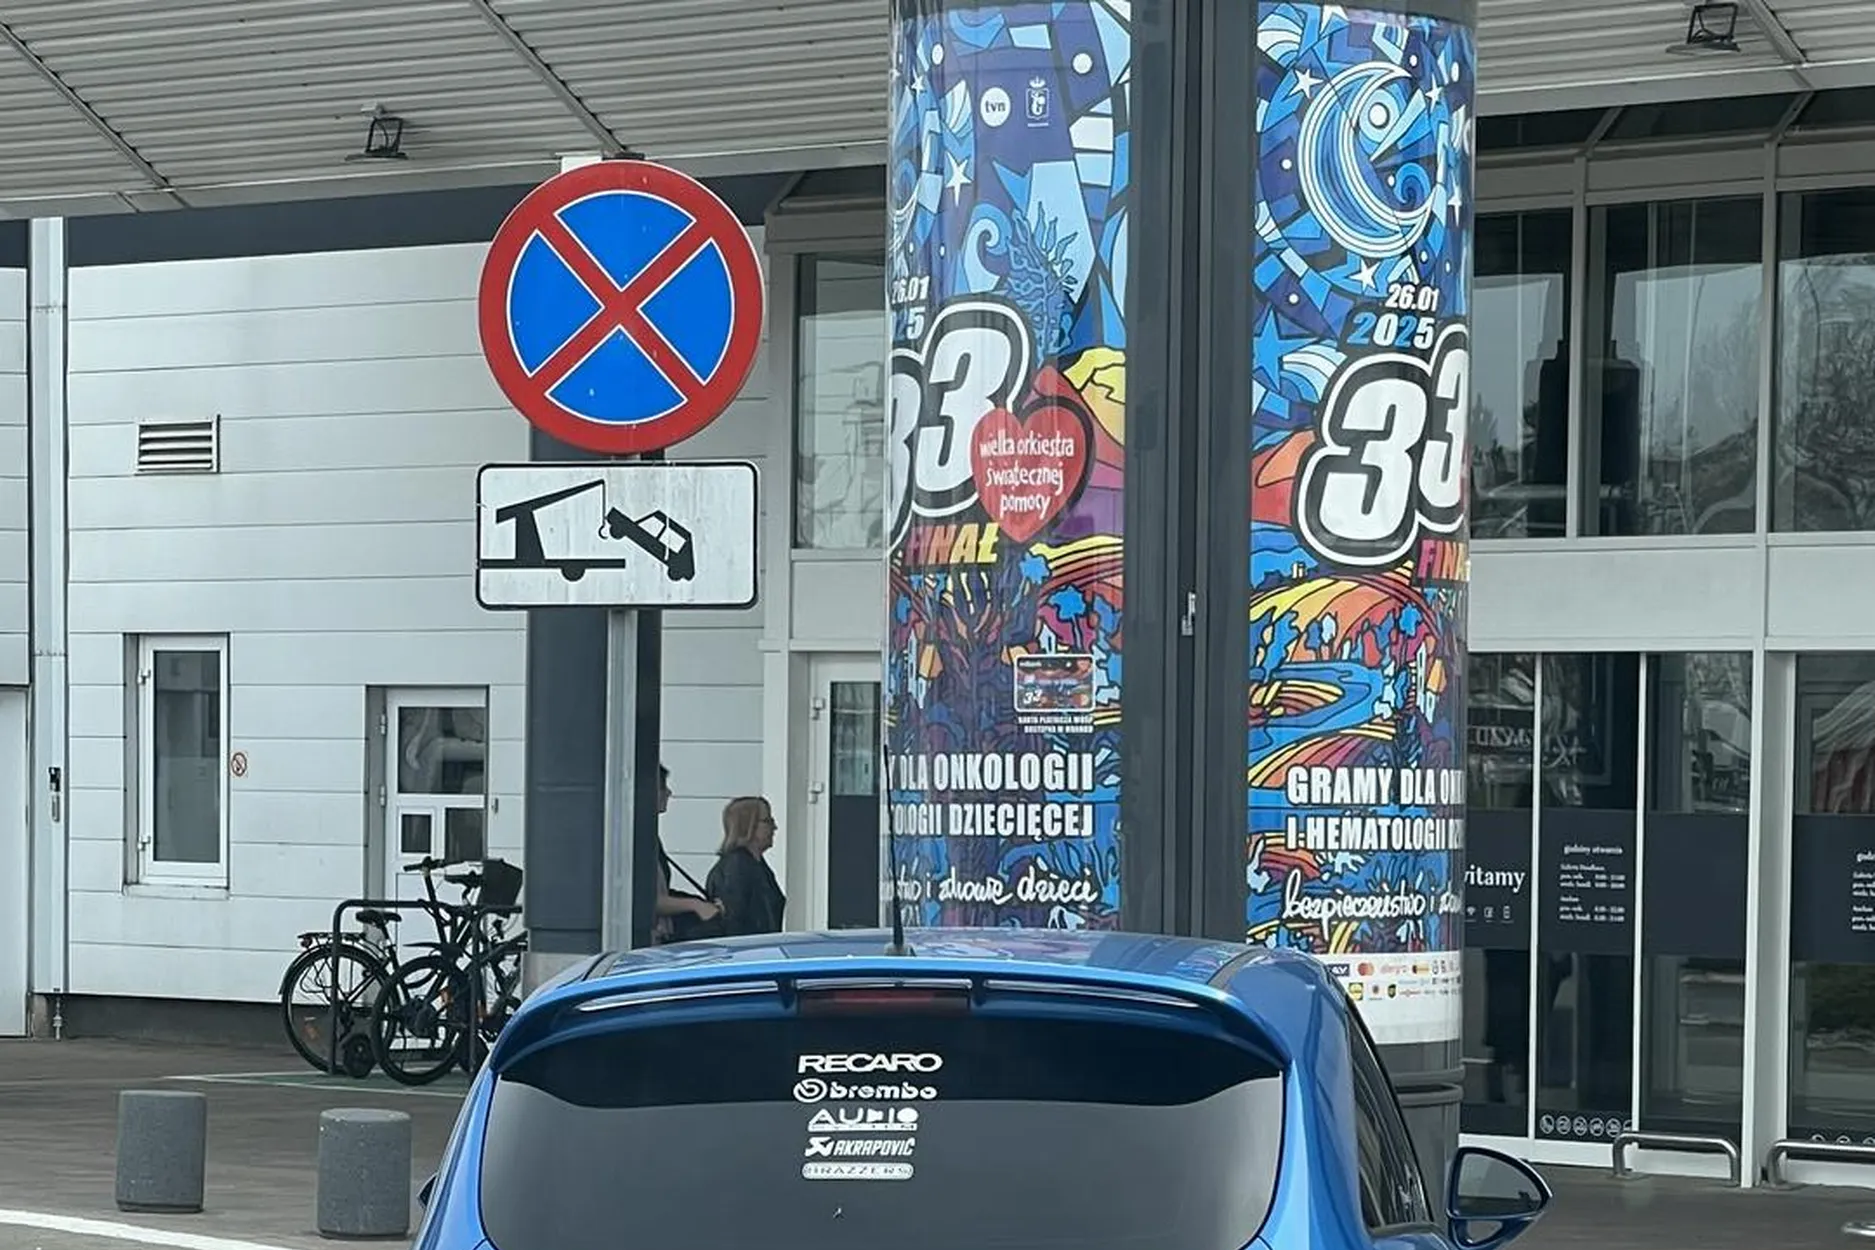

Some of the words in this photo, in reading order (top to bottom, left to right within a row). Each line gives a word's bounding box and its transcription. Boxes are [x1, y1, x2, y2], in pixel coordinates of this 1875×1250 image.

[985, 100, 1006, 113] tvn
[1385, 282, 1440, 311] 26.01
[1347, 311, 1436, 350] 2025
[1016, 430, 1075, 457] orkiestra
[985, 460, 1064, 496] świątecznej
[1000, 493, 1051, 520] pomocy
[900, 754, 928, 790] DLA
[933, 752, 1093, 791] ONKOLOGII
[1287, 766, 1393, 805] GRAMY
[1400, 768, 1435, 805] DLA
[950, 803, 1093, 842] DZIECIĘCEJ
[1306, 816, 1445, 850] HEMATOLOGII
[1016, 863, 1099, 903] dzieci
[797, 1053, 943, 1074] RECARO
[829, 1081, 938, 1099] brembo
